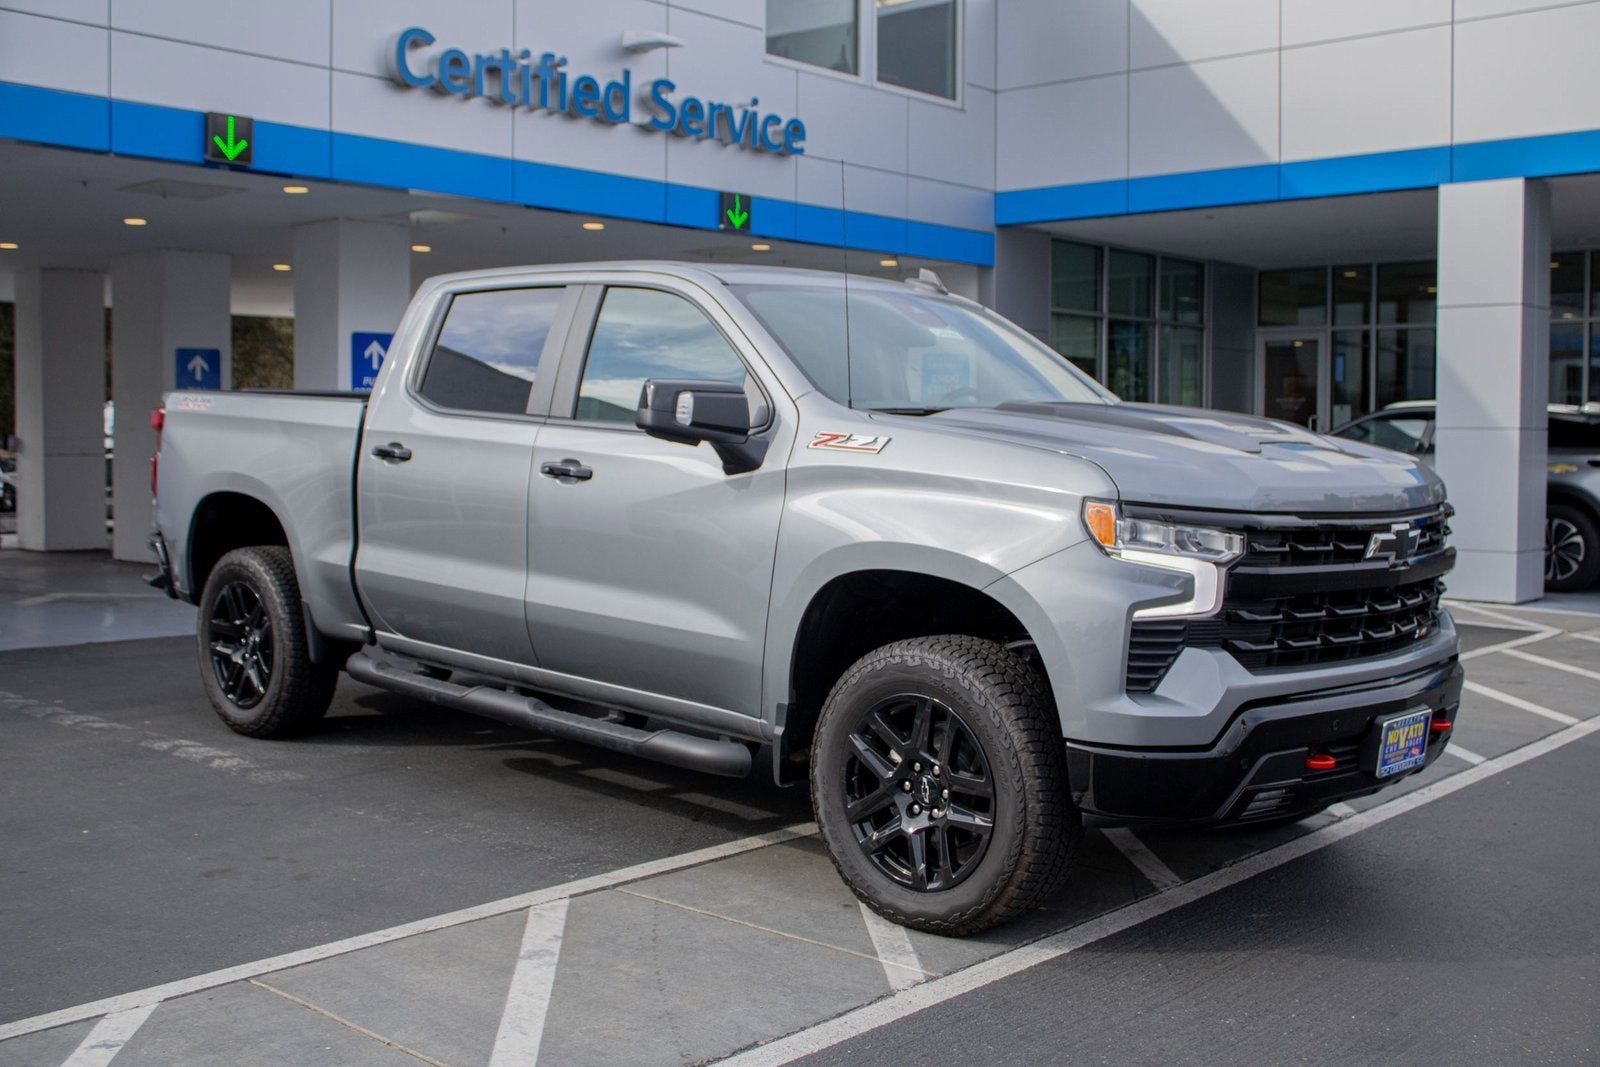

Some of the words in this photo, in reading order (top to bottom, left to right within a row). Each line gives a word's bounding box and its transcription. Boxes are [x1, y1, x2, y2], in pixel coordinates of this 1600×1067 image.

[395, 25, 631, 123] Certified
[650, 77, 807, 155] Service
[806, 430, 893, 454] Z71
[1387, 722, 1425, 747] NOVATO
